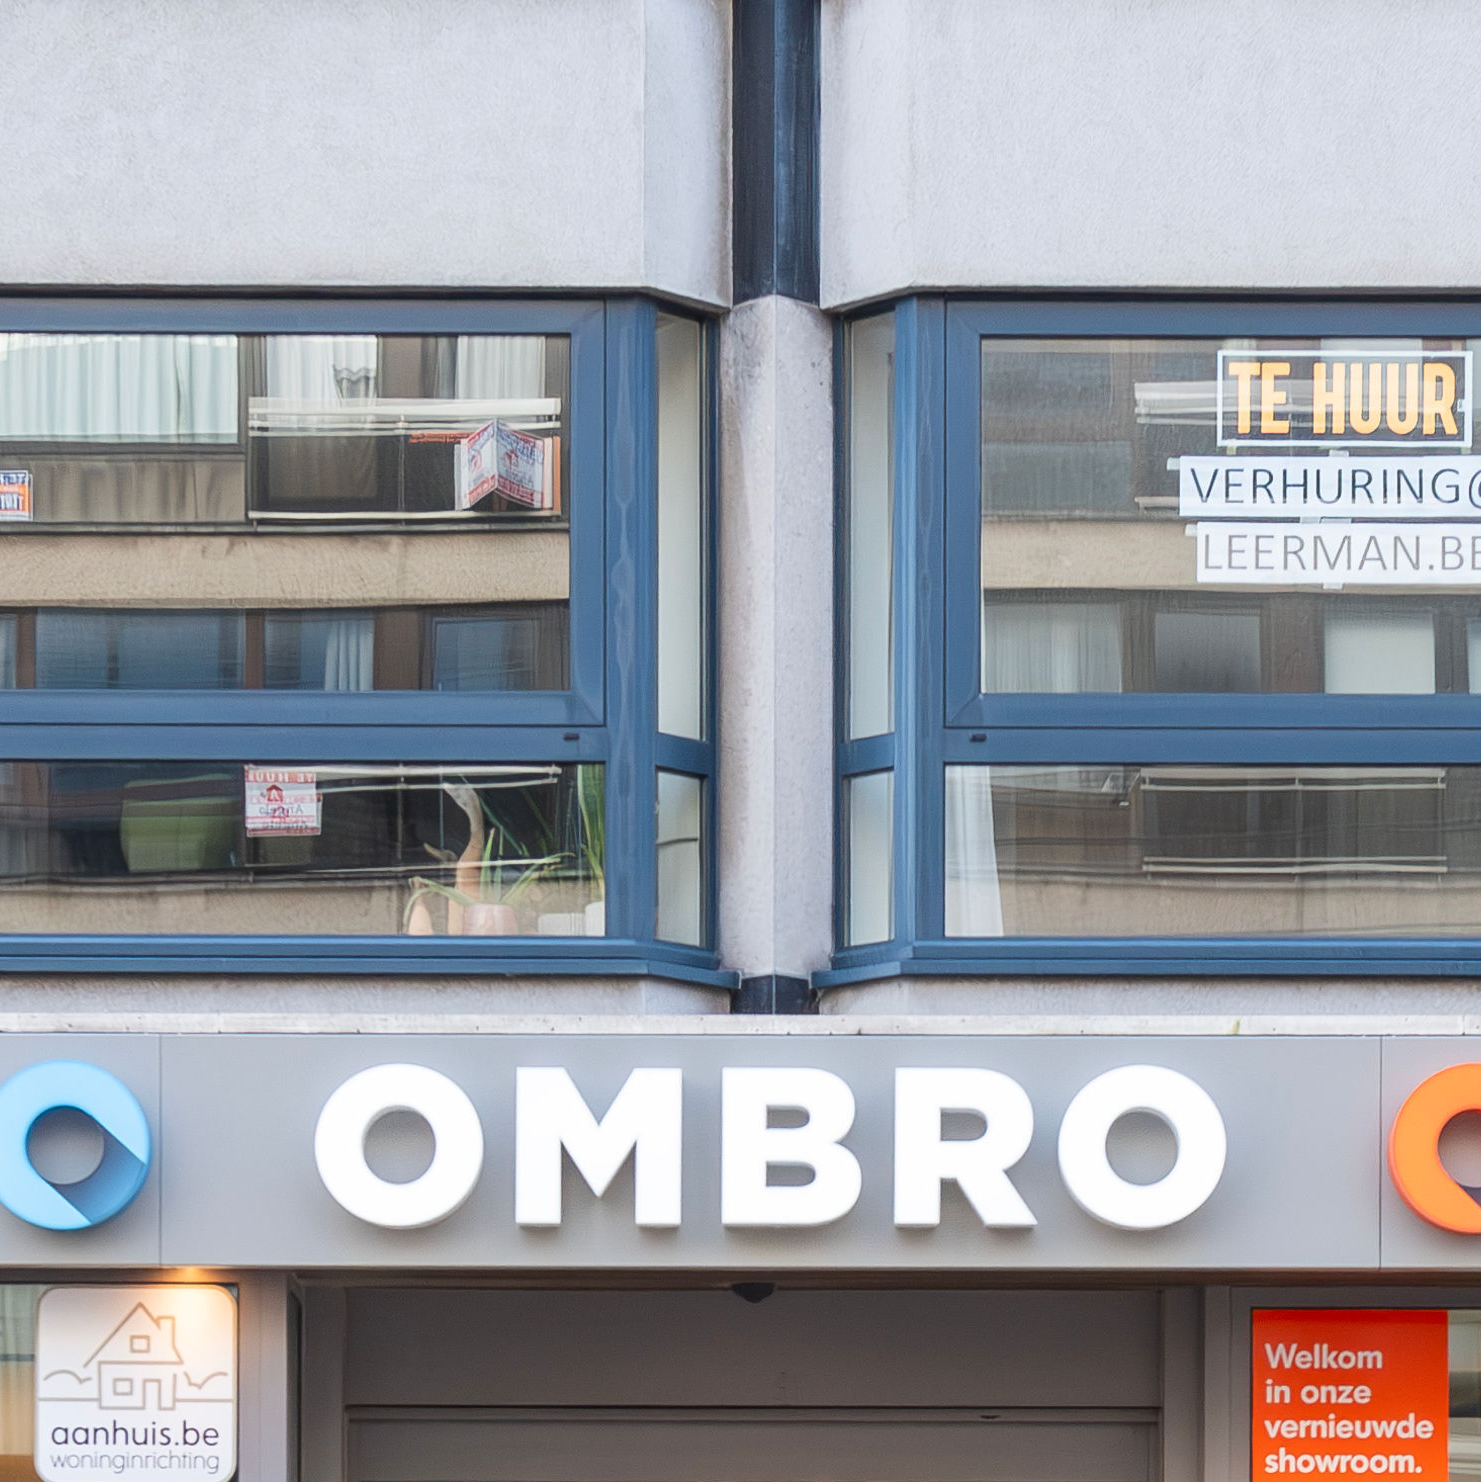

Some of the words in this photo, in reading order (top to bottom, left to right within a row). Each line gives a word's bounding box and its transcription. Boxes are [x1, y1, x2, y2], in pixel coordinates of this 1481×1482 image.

[1228, 361, 1291, 435] TE
[1312, 362, 1458, 436] HUUR
[314, 1062, 1228, 1231] OMBRO
[1264, 1342, 1383, 1369] Welkom
[1265, 1378, 1291, 1404] in
[1300, 1385, 1372, 1404] onze
[51, 1419, 219, 1446] aanhuis.be
[1264, 1412, 1435, 1438] vernieuwde
[50, 1450, 220, 1475] woninginrichting
[1264, 1447, 1422, 1474] showroom.
